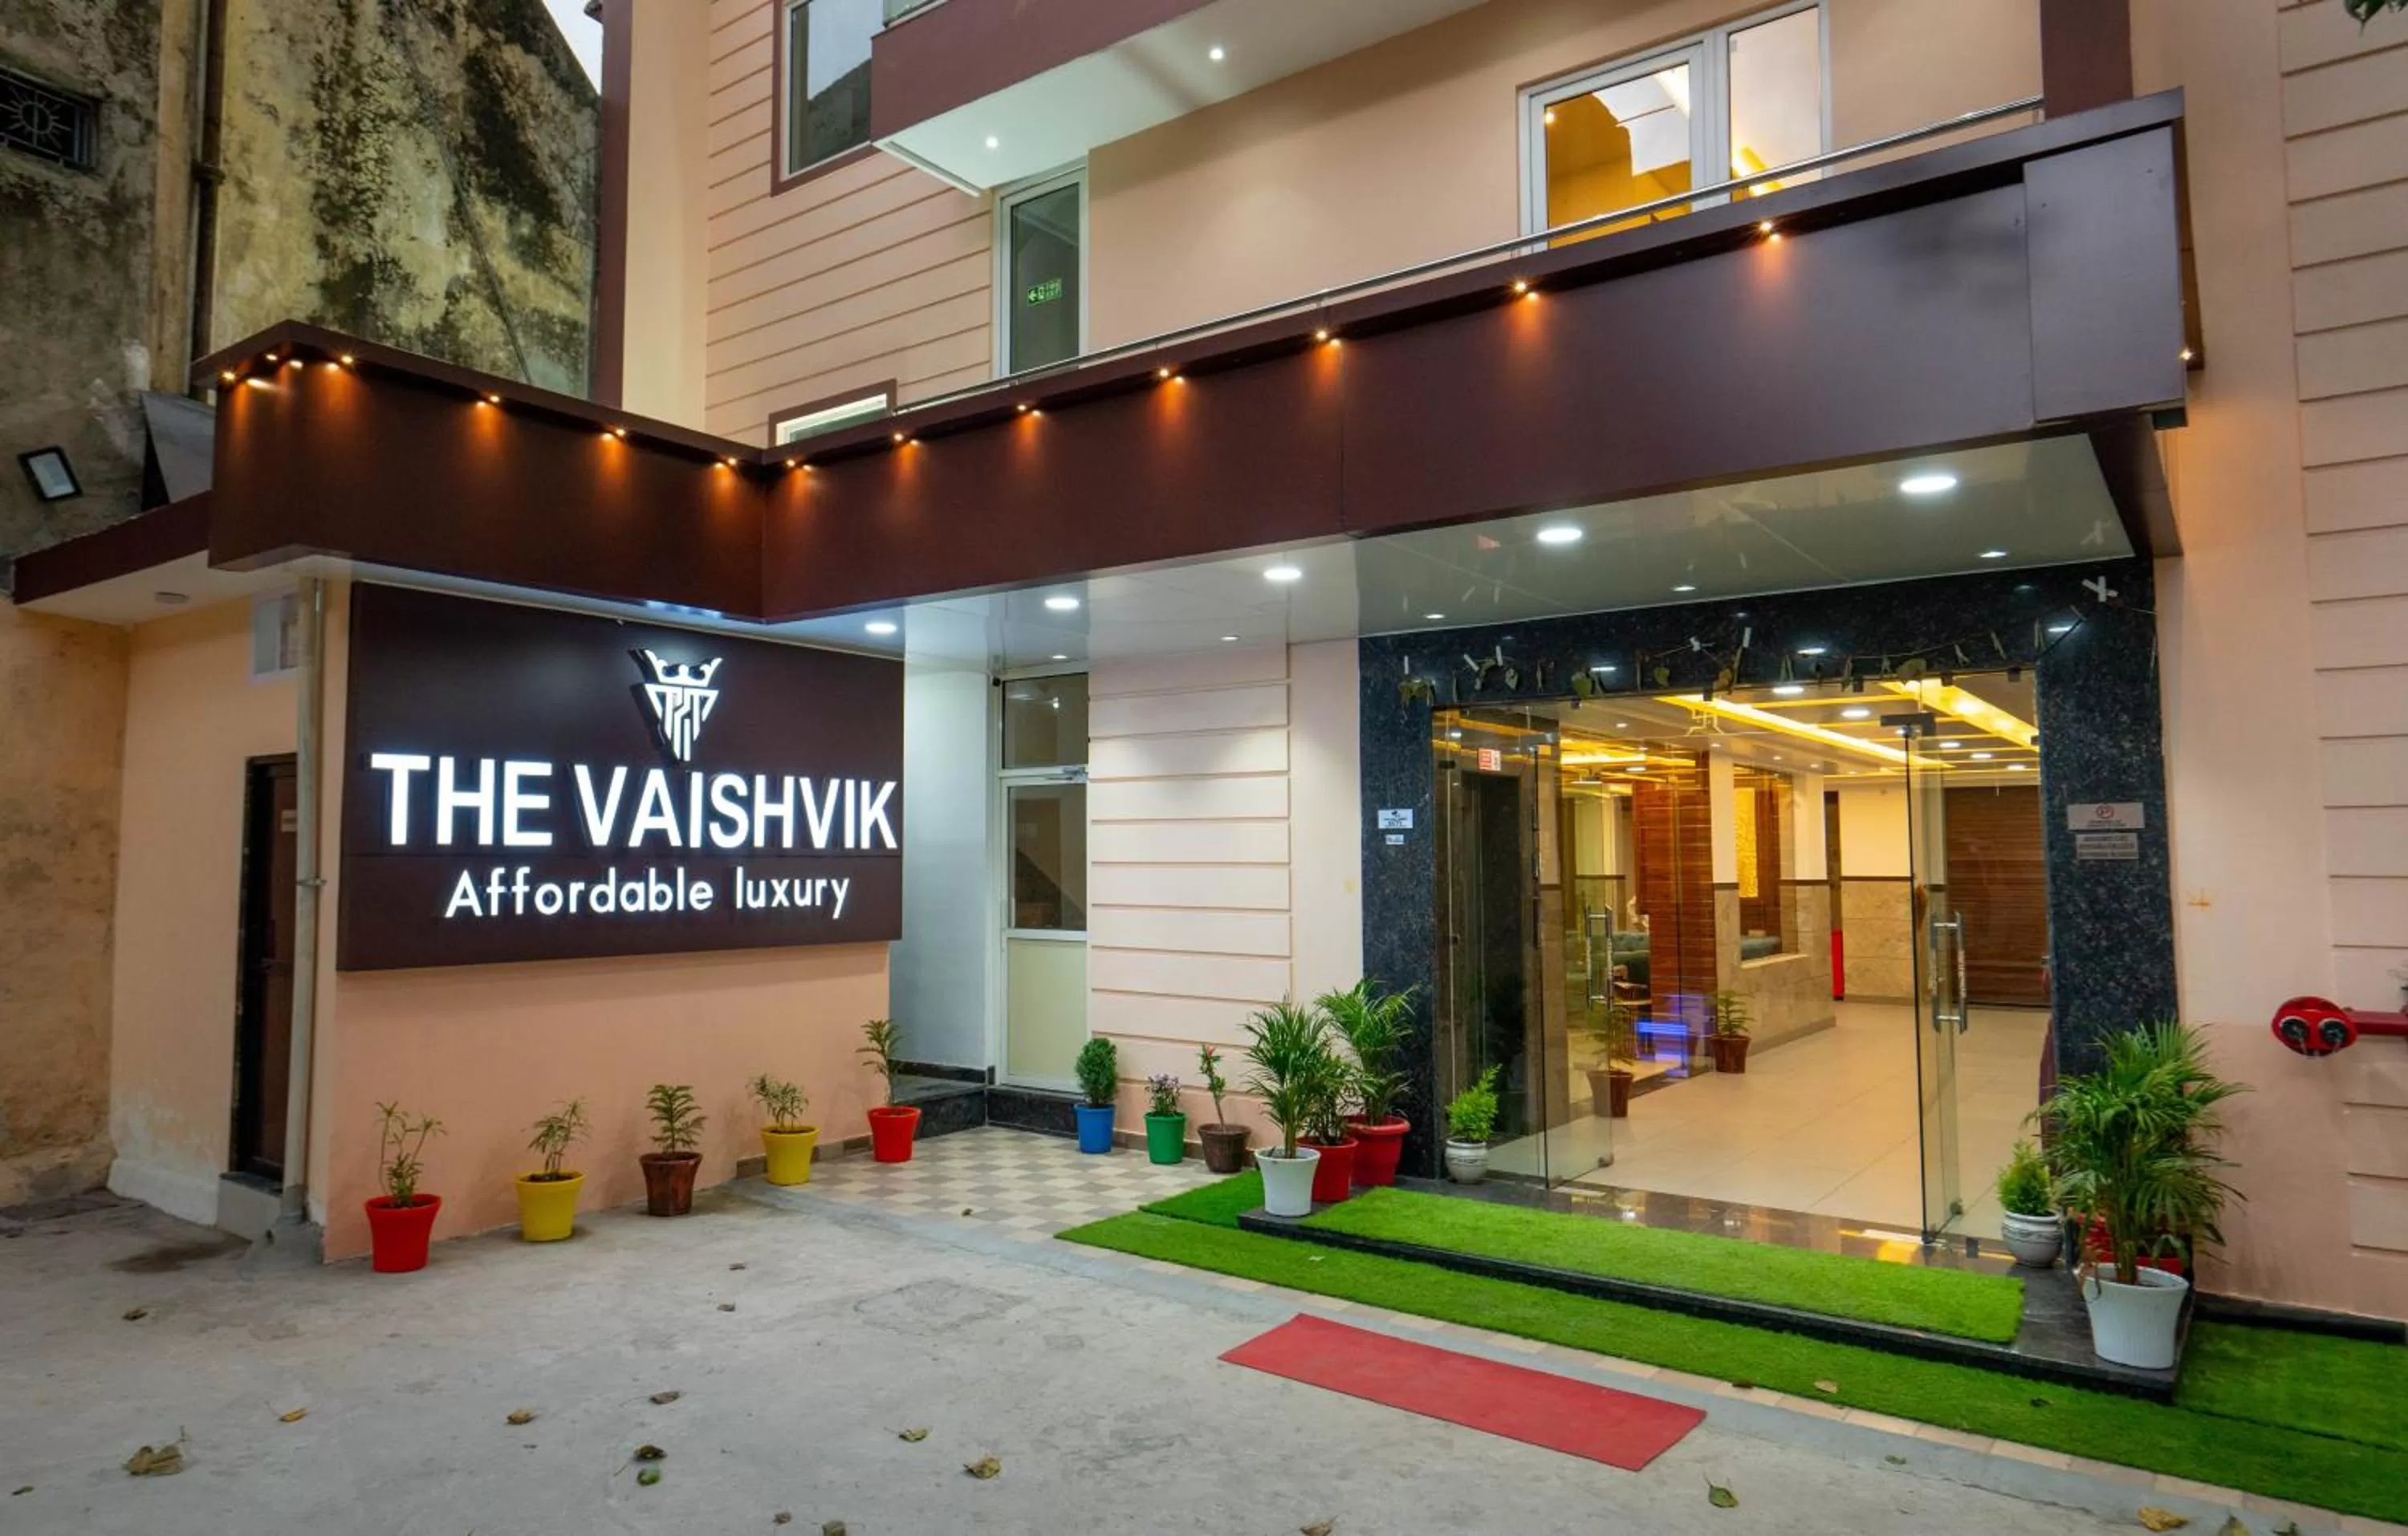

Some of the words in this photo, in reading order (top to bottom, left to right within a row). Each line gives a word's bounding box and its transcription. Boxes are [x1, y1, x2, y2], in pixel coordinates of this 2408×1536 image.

[371, 753, 552, 846] THE
[574, 764, 897, 849] VAISHVIK
[445, 866, 713, 917] Affordable
[736, 866, 848, 919] luxury
